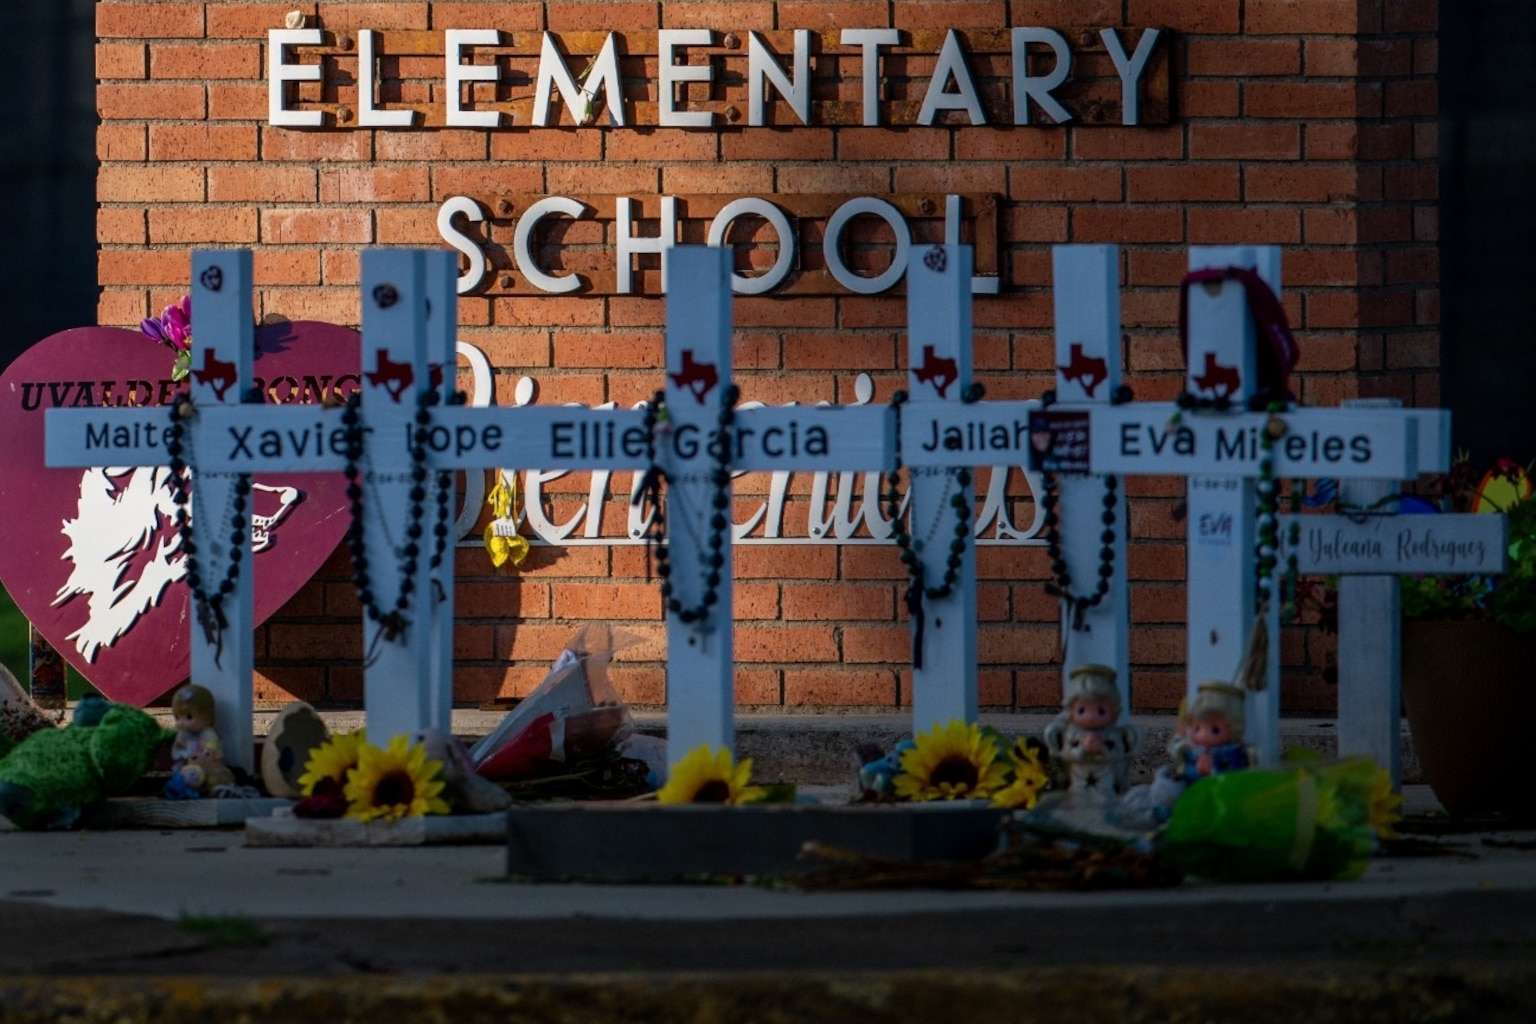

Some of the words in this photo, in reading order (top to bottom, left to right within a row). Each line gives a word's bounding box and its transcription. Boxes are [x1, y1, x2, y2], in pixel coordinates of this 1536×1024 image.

[268, 26, 1159, 128] ELEMENTARY
[437, 194, 999, 295] SCHOOL
[21, 378, 182, 412] UVALDE
[550, 422, 645, 458] Ellie
[672, 422, 829, 460] Garcia
[1120, 423, 1196, 456] Eva
[1215, 427, 1372, 463] Mieles
